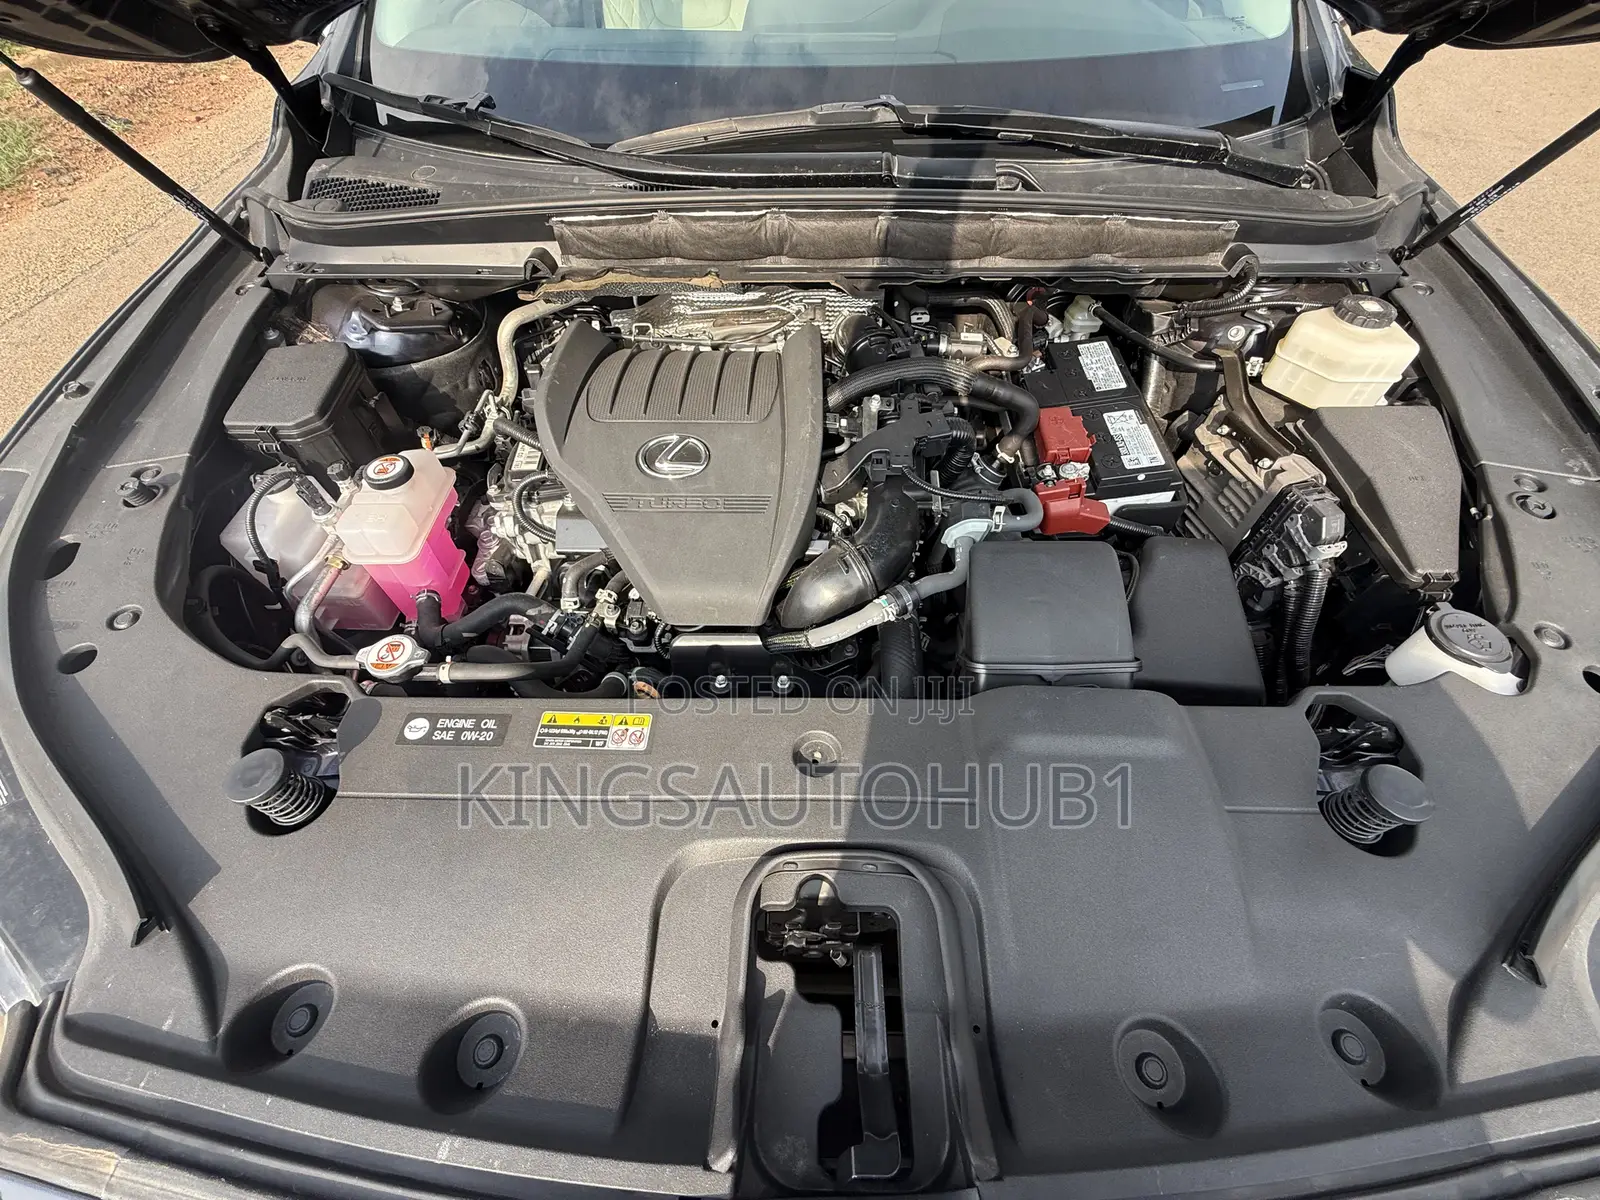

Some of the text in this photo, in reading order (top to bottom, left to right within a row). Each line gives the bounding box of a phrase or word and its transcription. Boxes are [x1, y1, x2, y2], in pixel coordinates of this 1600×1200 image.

[630, 496, 721, 509] TURBO
[436, 718, 498, 729] ENGINE OIL
[432, 730, 494, 741] SAE 0W-20
